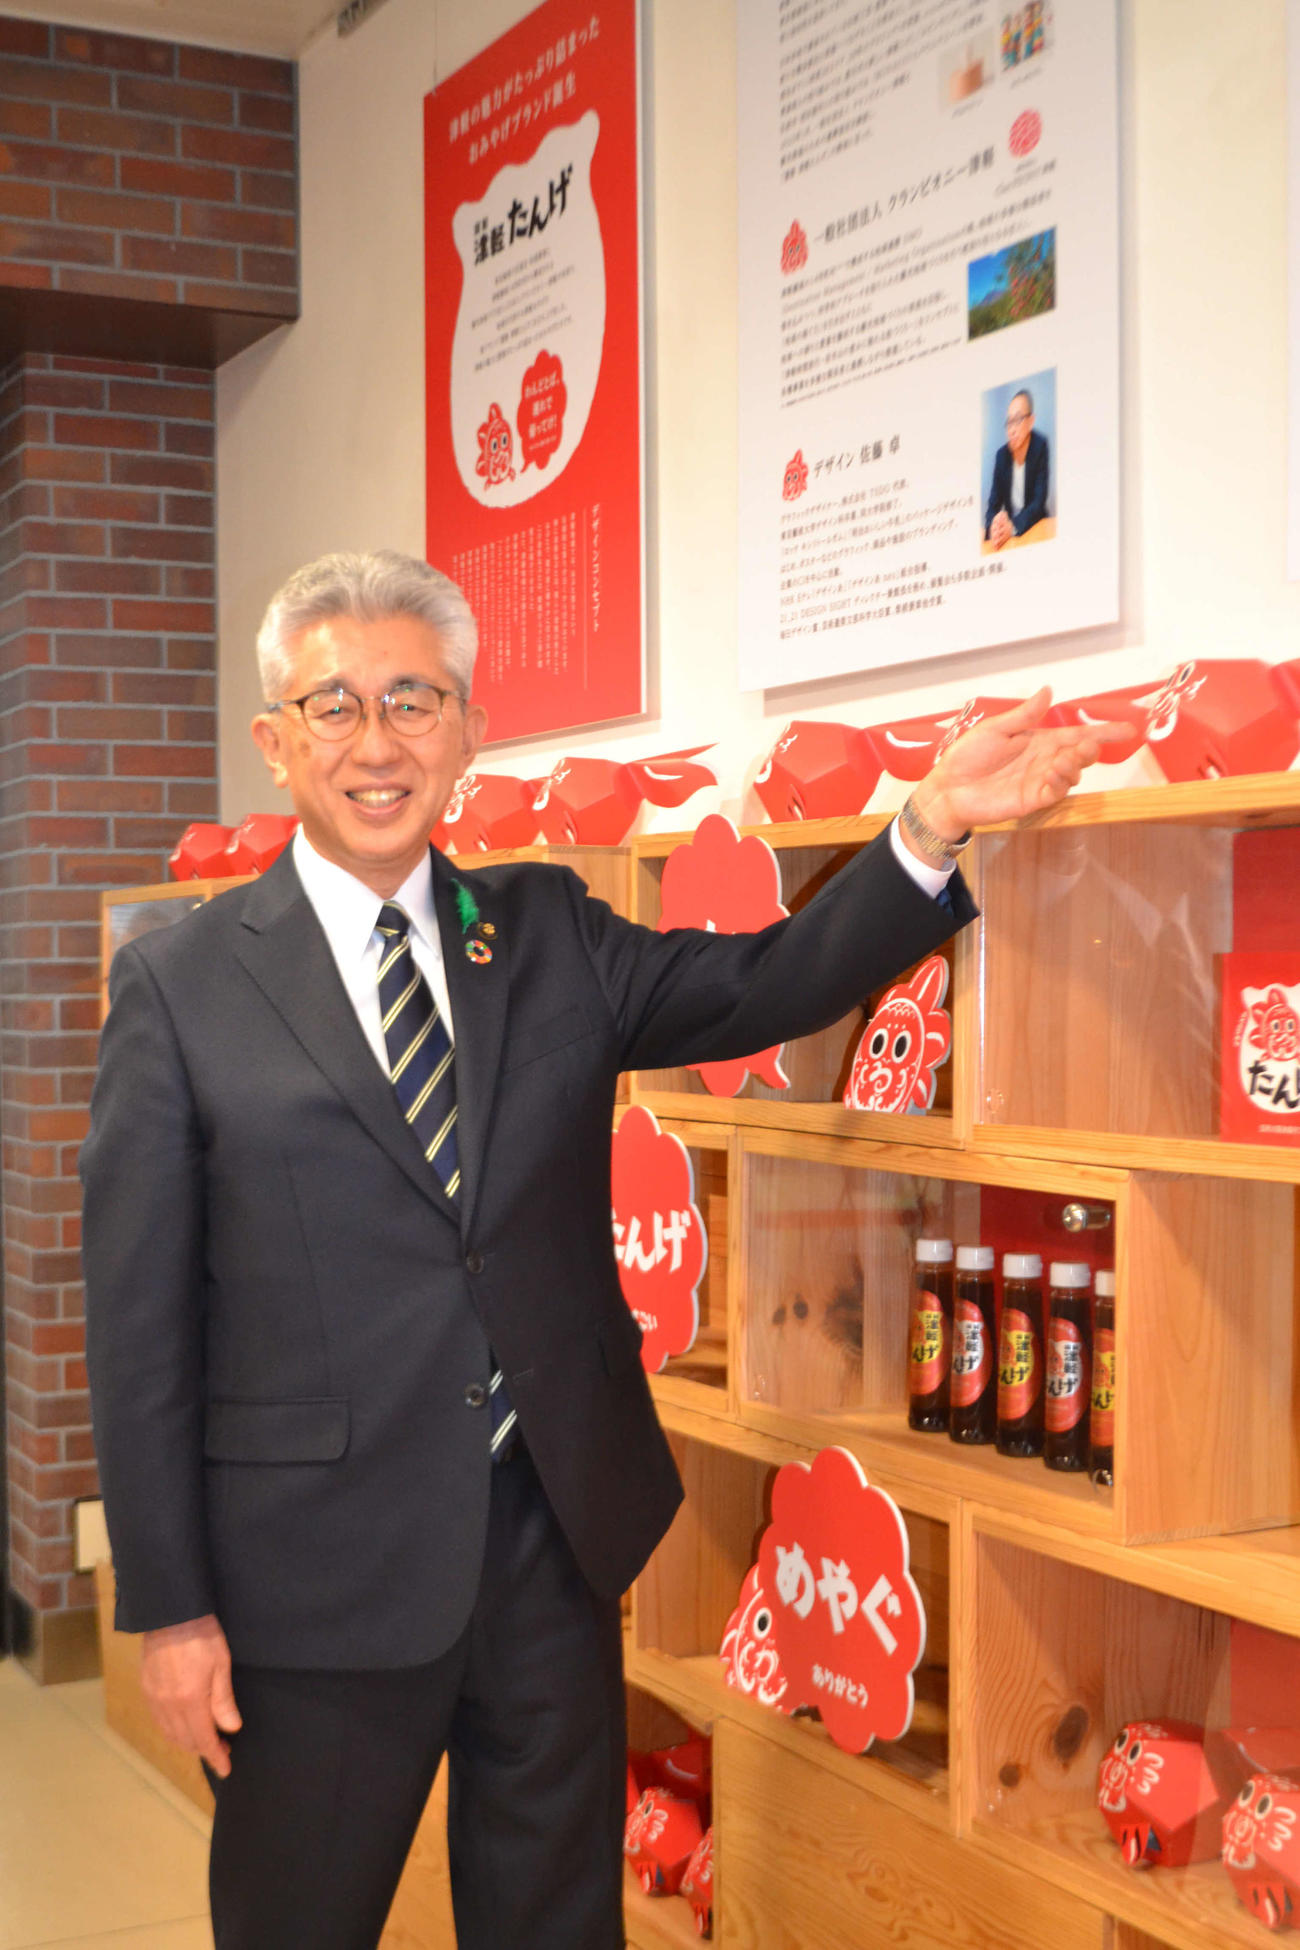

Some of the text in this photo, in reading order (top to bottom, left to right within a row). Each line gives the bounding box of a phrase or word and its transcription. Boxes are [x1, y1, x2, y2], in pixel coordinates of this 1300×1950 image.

[507, 163, 573, 246] たんげ
[814, 454, 854, 478] デザイン
[775, 1541, 902, 1657] めやぐ
[812, 1662, 869, 1709] ありがとう
